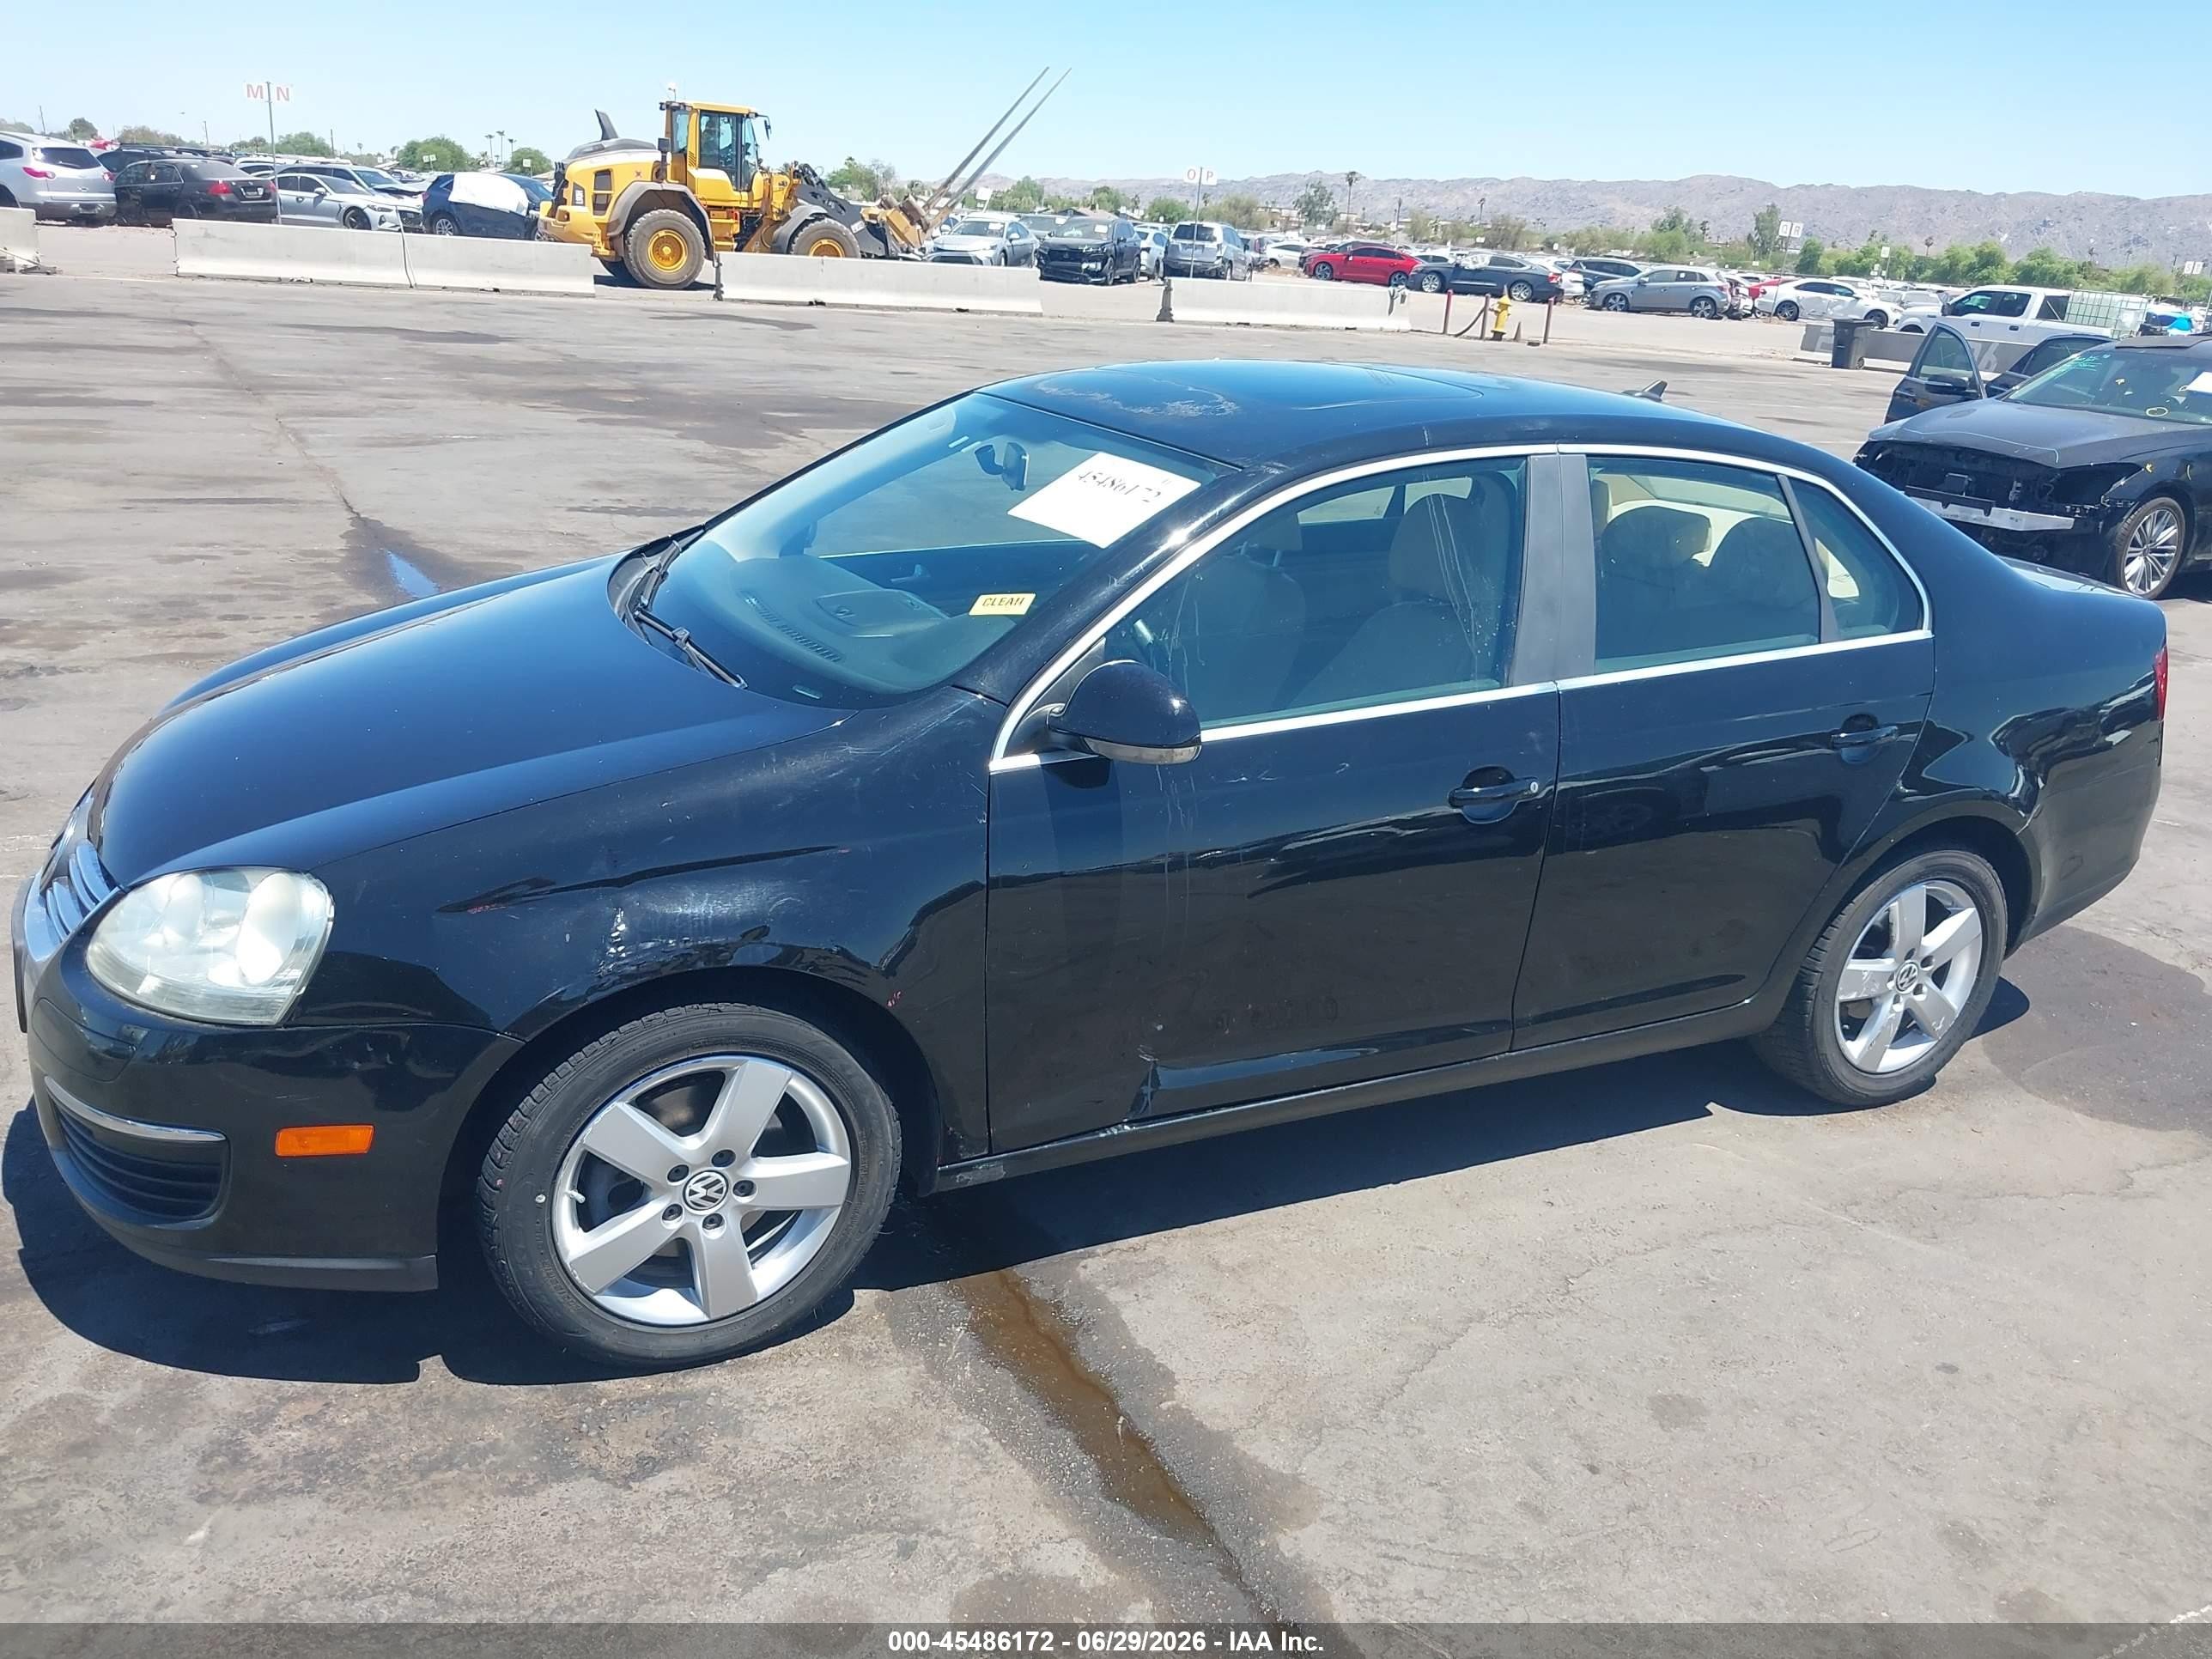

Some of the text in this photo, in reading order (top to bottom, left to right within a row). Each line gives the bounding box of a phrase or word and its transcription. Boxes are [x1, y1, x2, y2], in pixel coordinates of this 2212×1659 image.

[246, 83, 290, 101] M N
[1206, 170, 1214, 181] P
